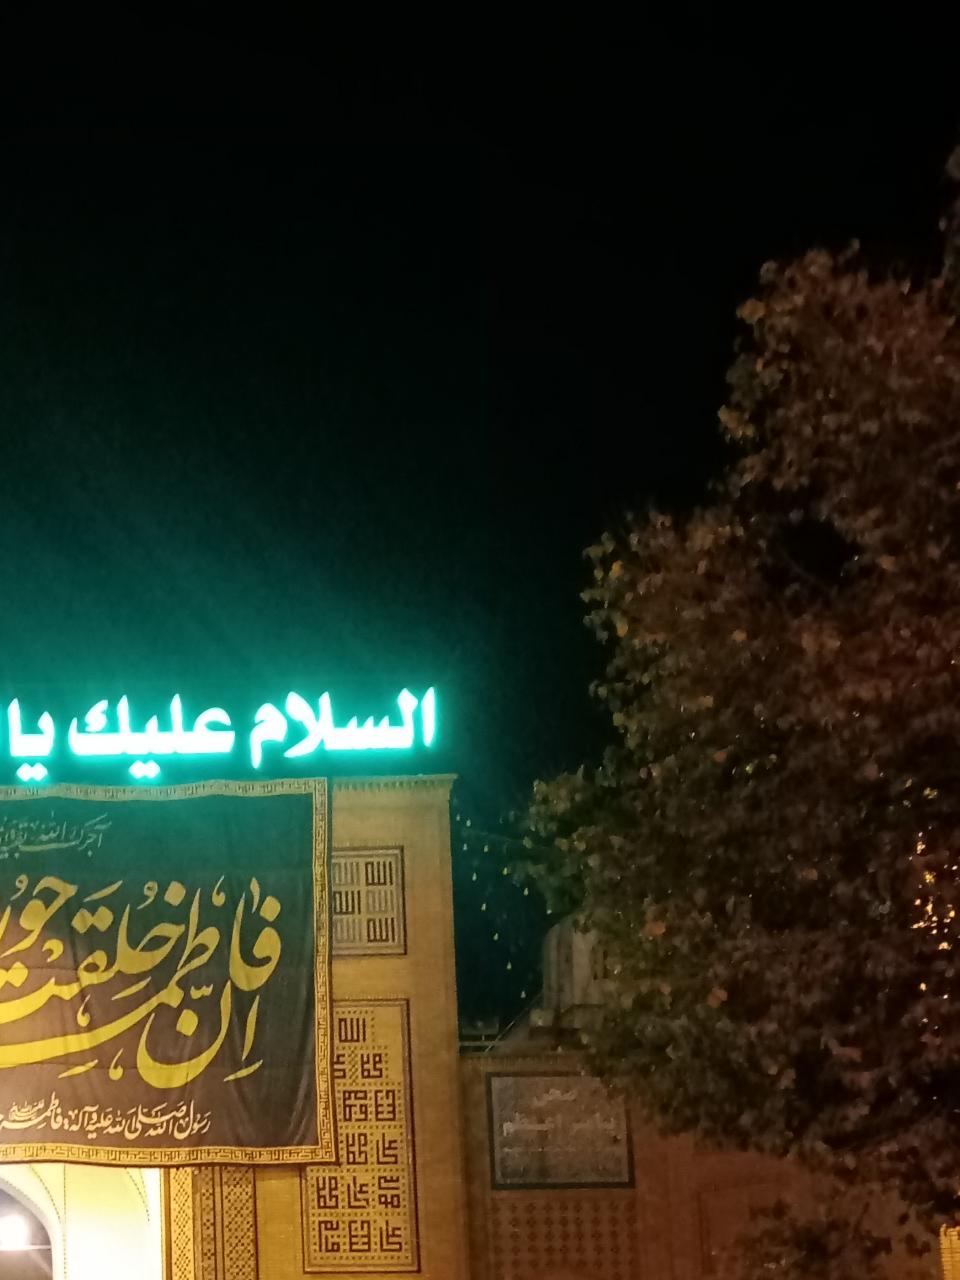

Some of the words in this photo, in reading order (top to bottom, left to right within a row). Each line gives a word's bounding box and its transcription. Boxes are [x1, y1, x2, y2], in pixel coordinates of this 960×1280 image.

[250, 686, 436, 769] السلام
[365, 861, 393, 886] الله
[367, 917, 396, 943] الله
[339, 1018, 366, 1042] الله
